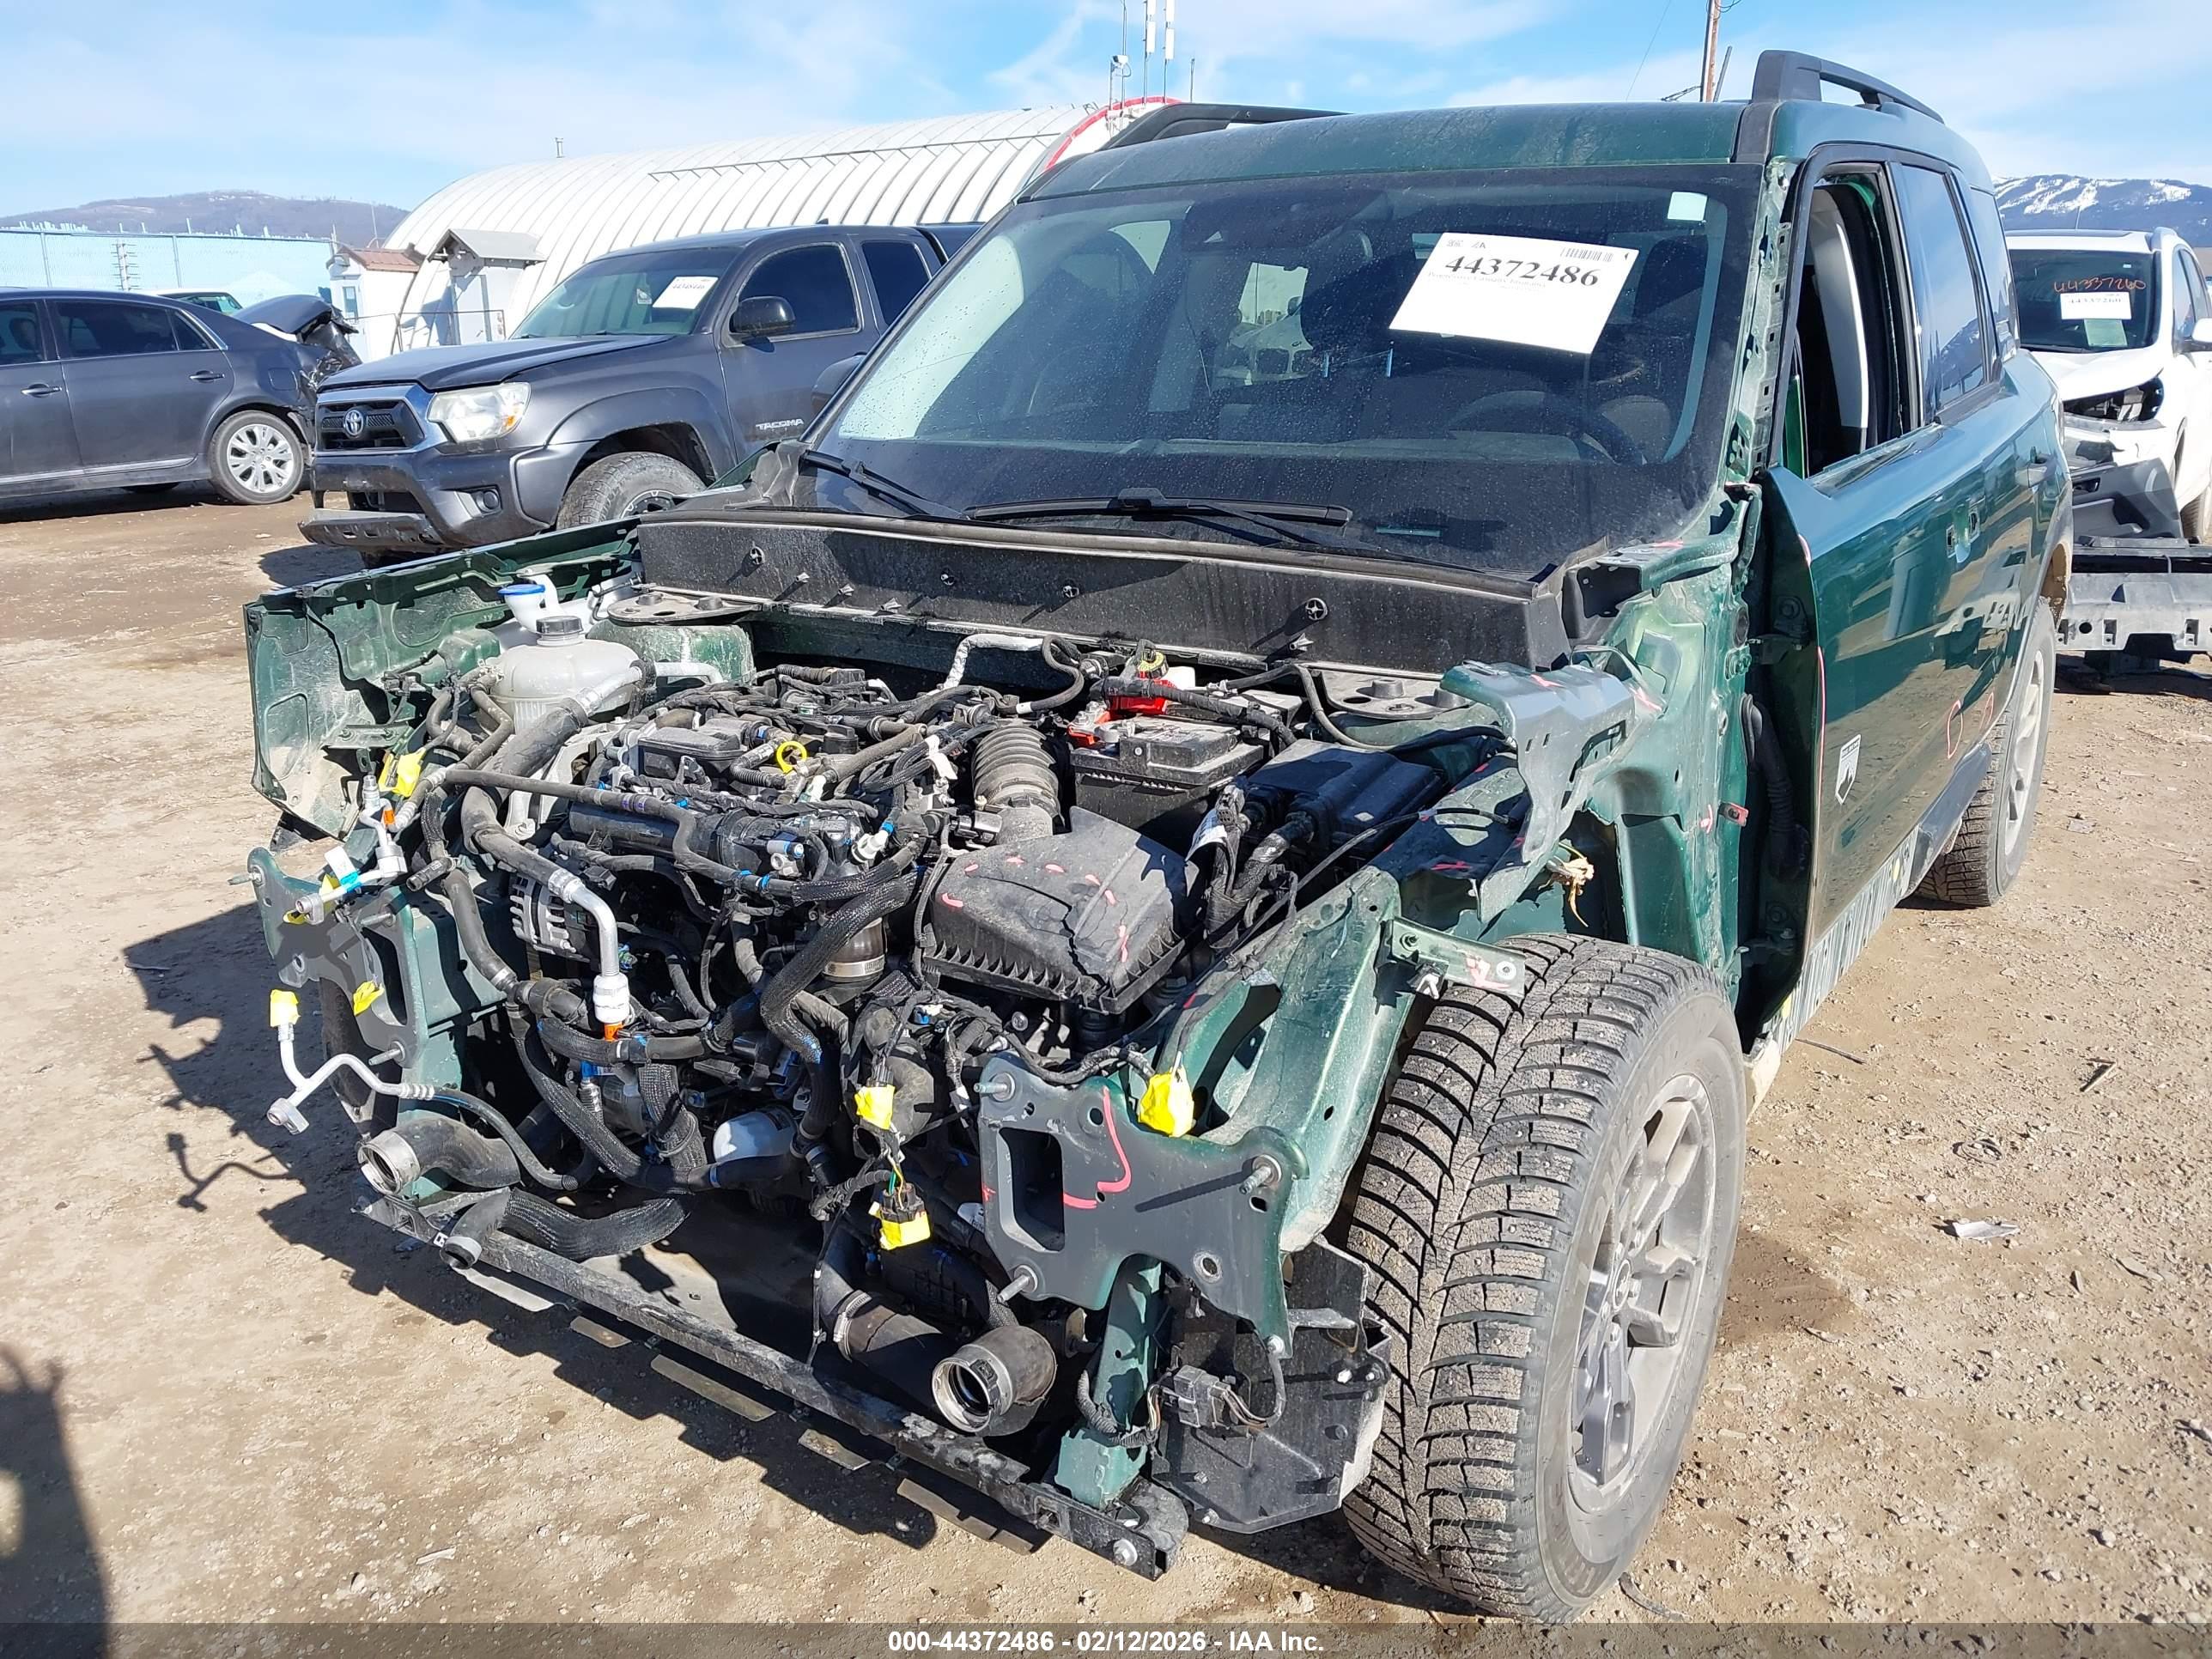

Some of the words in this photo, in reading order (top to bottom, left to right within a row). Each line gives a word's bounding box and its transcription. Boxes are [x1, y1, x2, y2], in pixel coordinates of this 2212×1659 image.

[1445, 256, 1601, 286] 44372486
[2054, 276, 2147, 293] 44337260
[755, 418, 805, 430] TACOMA
